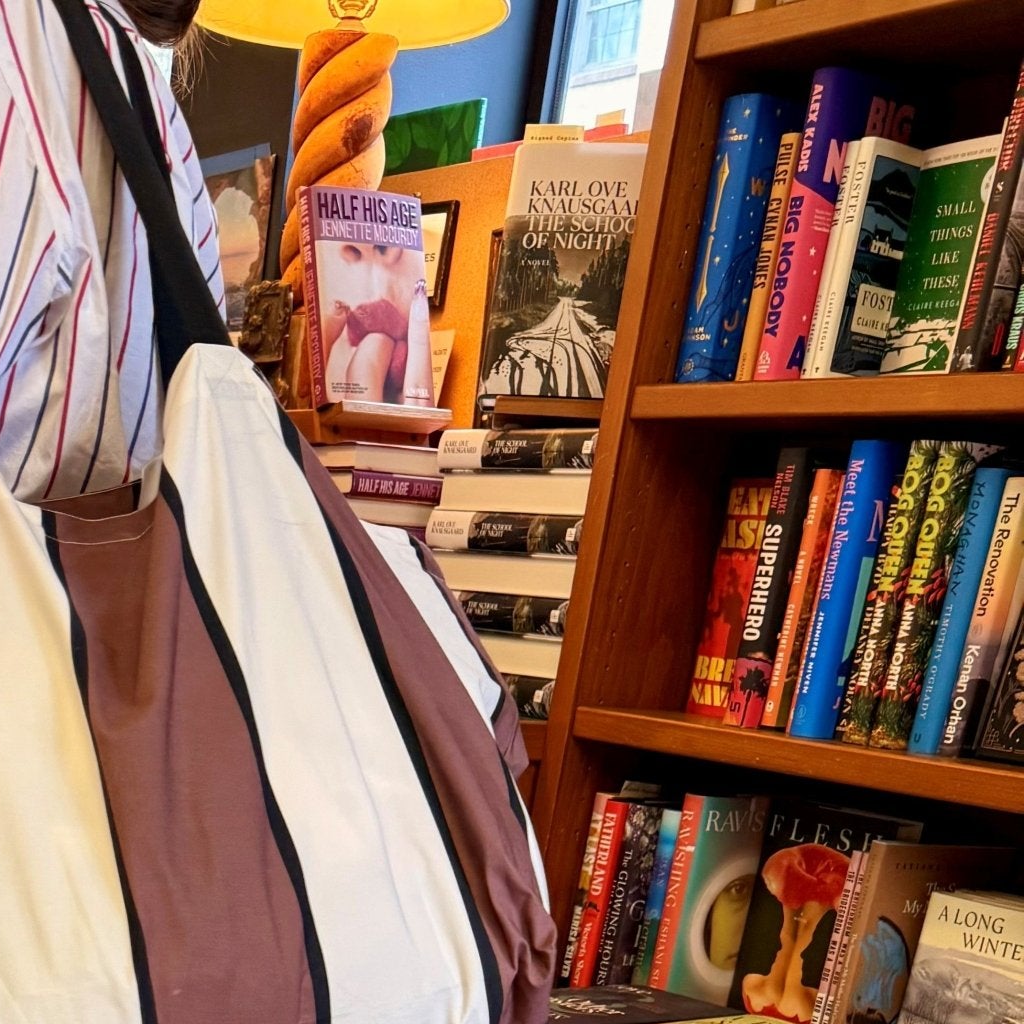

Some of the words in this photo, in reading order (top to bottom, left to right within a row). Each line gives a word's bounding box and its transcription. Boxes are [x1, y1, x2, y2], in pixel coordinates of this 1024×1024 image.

[807, 83, 824, 123] ALEX
[865, 96, 915, 144] BIG
[775, 142, 793, 186] PULSE
[796, 126, 816, 174] KADIS
[300, 195, 310, 222] HALF
[530, 180, 583, 198] KARL
[588, 180, 628, 198] OVE
[830, 165, 851, 228] FOSTER
[844, 161, 866, 224] FOSTER
[317, 191, 359, 221] HALF
[363, 196, 388, 224] HIS
[391, 199, 419, 229] AGE
[320, 219, 372, 240] JENNETTE
[526, 215, 565, 232] THE
[759, 197, 782, 242] CYNAN
[784, 195, 805, 235] BIG
[935, 201, 976, 218] SMALL
[522, 232, 550, 250] OF
[553, 233, 617, 250] NIGHT
[929, 225, 973, 243] THINGS
[979, 212, 1000, 257] DANIEL
[527, 259, 550, 268] NOVEL
[753, 245, 773, 291] JONES
[931, 250, 960, 265] LIKE
[763, 241, 794, 339] NOBODY
[922, 275, 961, 290] THESE
[856, 317, 880, 331] CLAIRE
[908, 300, 933, 312] CLAIRE
[494, 439, 506, 448] THE
[507, 440, 528, 448] SCHOOL
[502, 446, 519, 455] NIGHT
[357, 478, 379, 494] HALF
[379, 480, 393, 495] HIS
[393, 481, 410, 496] AGE
[786, 464, 796, 482] TIM
[850, 458, 865, 497] Meet
[898, 453, 924, 512] BOG
[927, 454, 956, 513] BOG
[777, 483, 792, 516] BLAKE
[806, 495, 819, 526] WRECK
[843, 498, 855, 525] the
[1000, 493, 1021, 524] The
[431, 527, 464, 535] KNAUSGAARD
[481, 522, 491, 531] THE
[492, 523, 513, 532] SCHOOL
[488, 529, 504, 538] NIGHT
[948, 481, 987, 597] MONAGHAN
[821, 527, 849, 601] Newmans
[877, 516, 910, 594] QUEEN
[906, 517, 940, 595] QUEEN
[975, 528, 1011, 618] Renovation
[743, 523, 783, 642] SUPERHERO
[474, 607, 490, 616] NIGHT
[479, 602, 498, 611] SCHOOL
[868, 600, 887, 642] ANNA
[900, 603, 916, 643] ANNA
[782, 603, 795, 651] CATHERINE
[810, 610, 825, 660] JENNIFER
[931, 603, 953, 663] TIMOTHY
[771, 652, 785, 687] NEWMAN
[802, 661, 815, 694] NIVEN
[858, 642, 877, 688] NORTH
[885, 644, 906, 690] NORTH
[960, 645, 981, 693] Kenan
[943, 697, 967, 745] Orhan
[589, 812, 618, 896] FATHERLAND
[769, 814, 885, 854] FLESH
[621, 849, 633, 868] The
[610, 870, 628, 935] GLOWING
[834, 889, 851, 934] BRIDEGROOM
[937, 904, 950, 920] A
[952, 908, 1005, 935] LONG
[596, 938, 615, 987] HOURS
[962, 931, 1024, 962] WINTE
